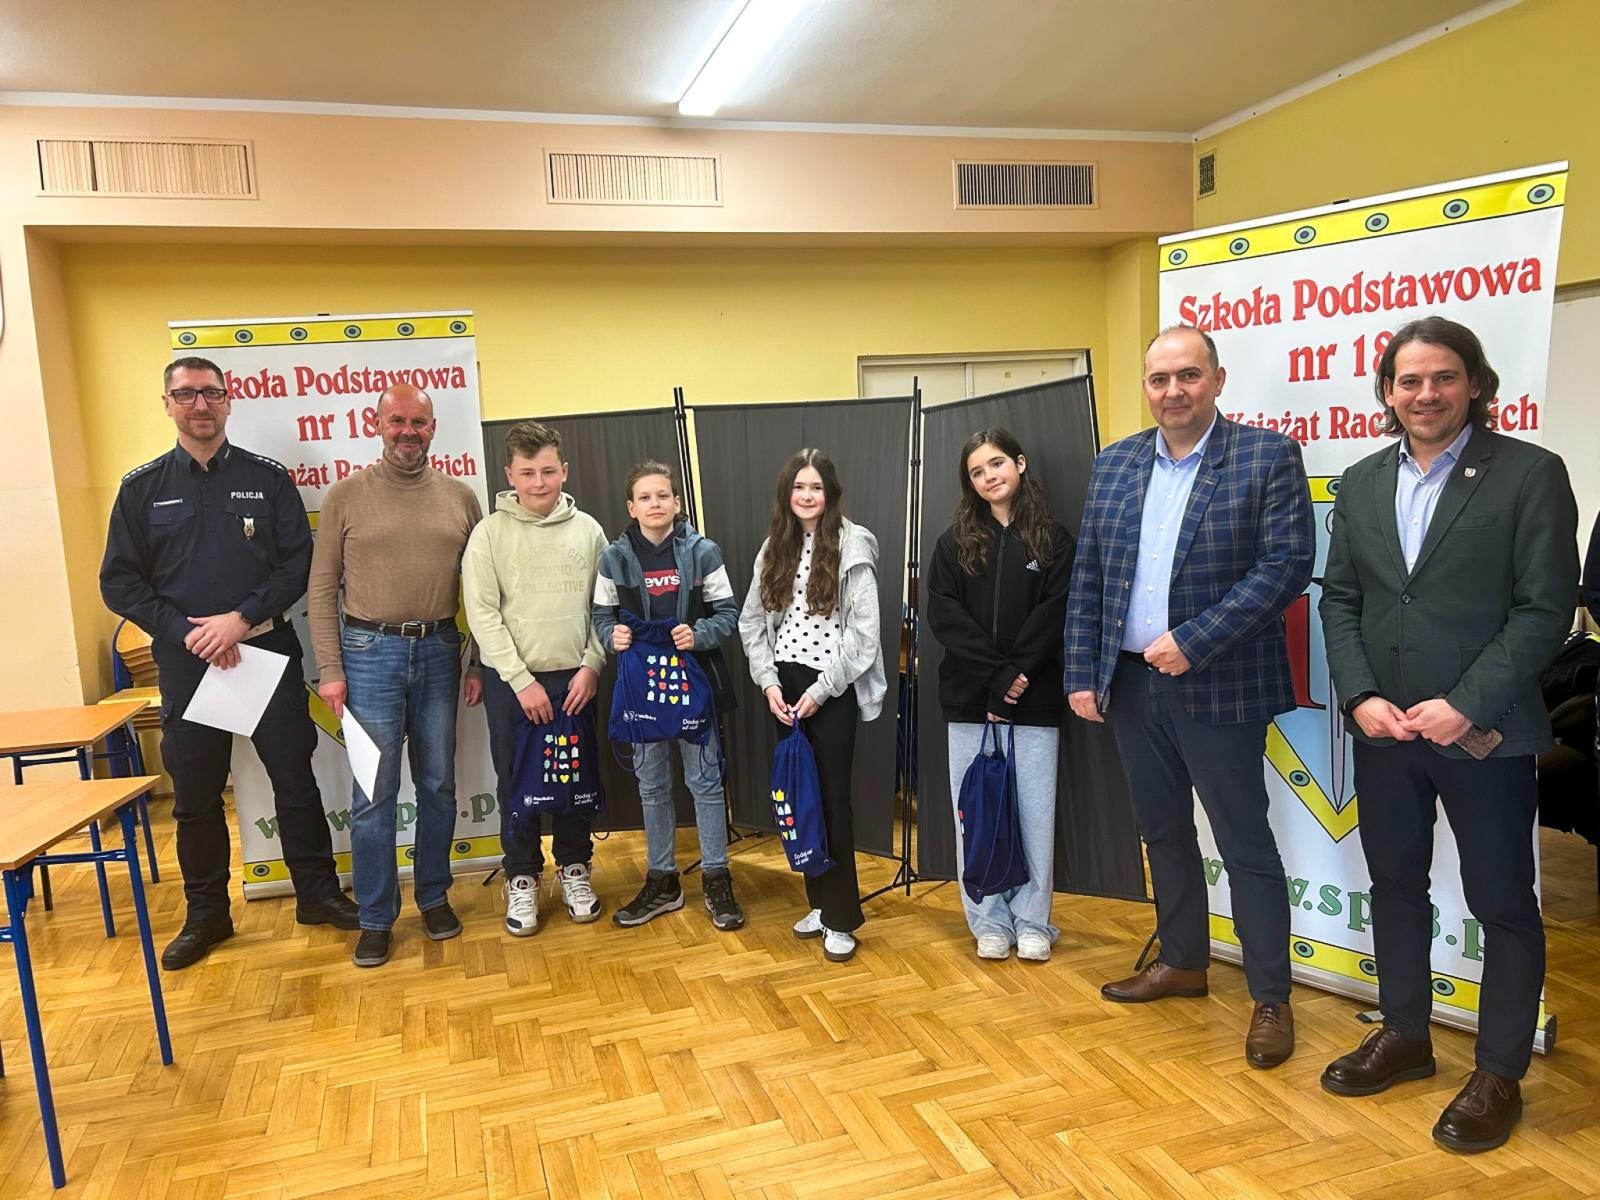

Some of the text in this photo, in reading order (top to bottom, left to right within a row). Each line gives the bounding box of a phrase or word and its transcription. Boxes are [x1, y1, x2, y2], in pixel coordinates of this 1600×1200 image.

[1179, 257, 1542, 334] Szkoła Podstawowa
[1288, 343, 1337, 382] nr
[223, 364, 467, 399] koła Podstawowa
[297, 406, 379, 442] nr 18
[1226, 410, 1320, 447] iążąt
[230, 491, 264, 500] POLICJA
